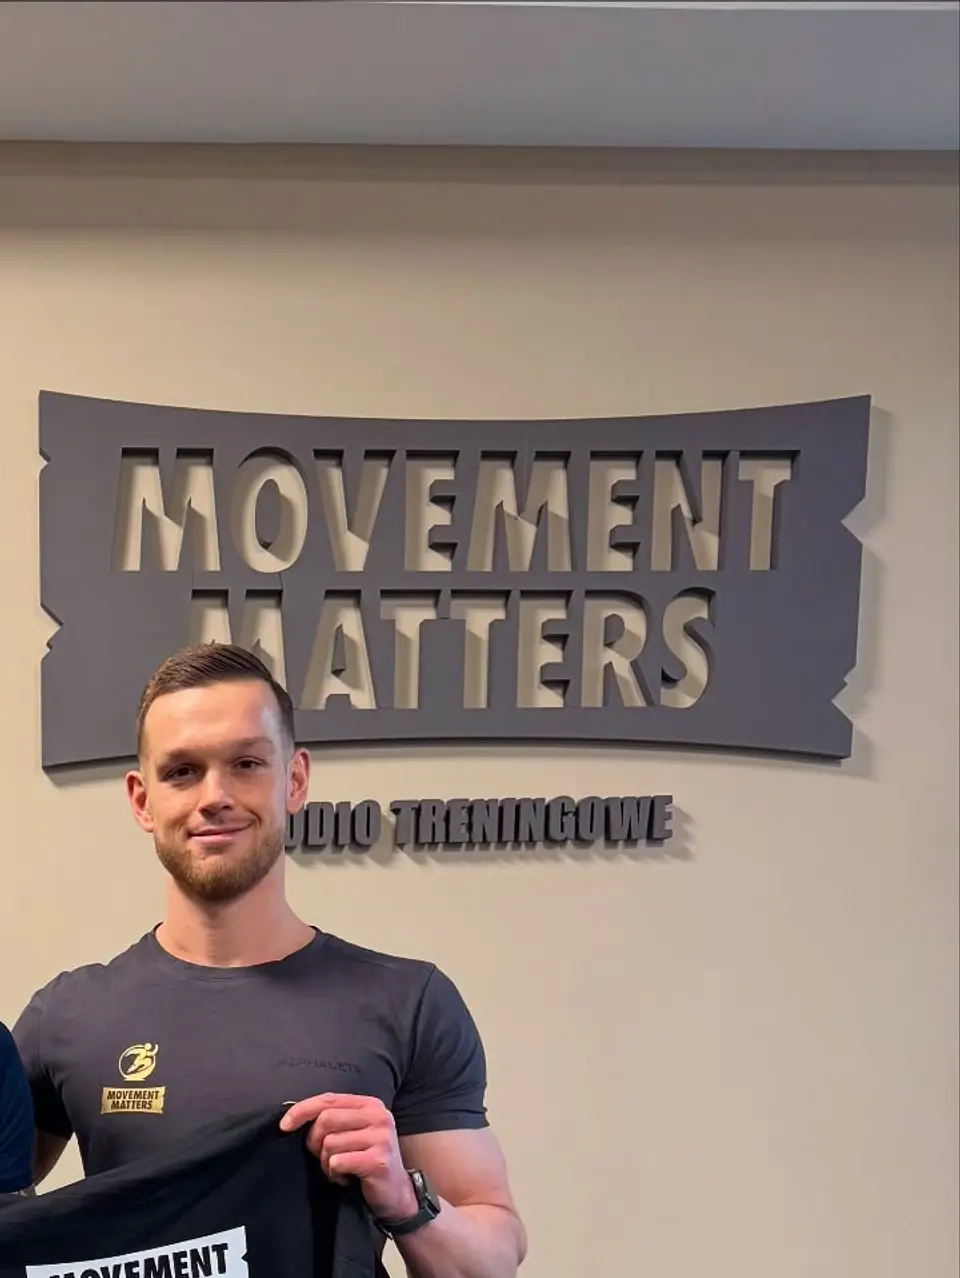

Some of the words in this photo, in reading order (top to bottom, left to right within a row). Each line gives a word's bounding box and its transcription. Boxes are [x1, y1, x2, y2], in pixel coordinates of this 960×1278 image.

[112, 446, 801, 573] MOVEMENT
[190, 588, 717, 709] MATTERS
[286, 799, 381, 850] UDIO
[390, 795, 673, 848] TRENINGOWE
[107, 1090, 160, 1100] MOVEMENT
[111, 1100, 153, 1110] MATTERS
